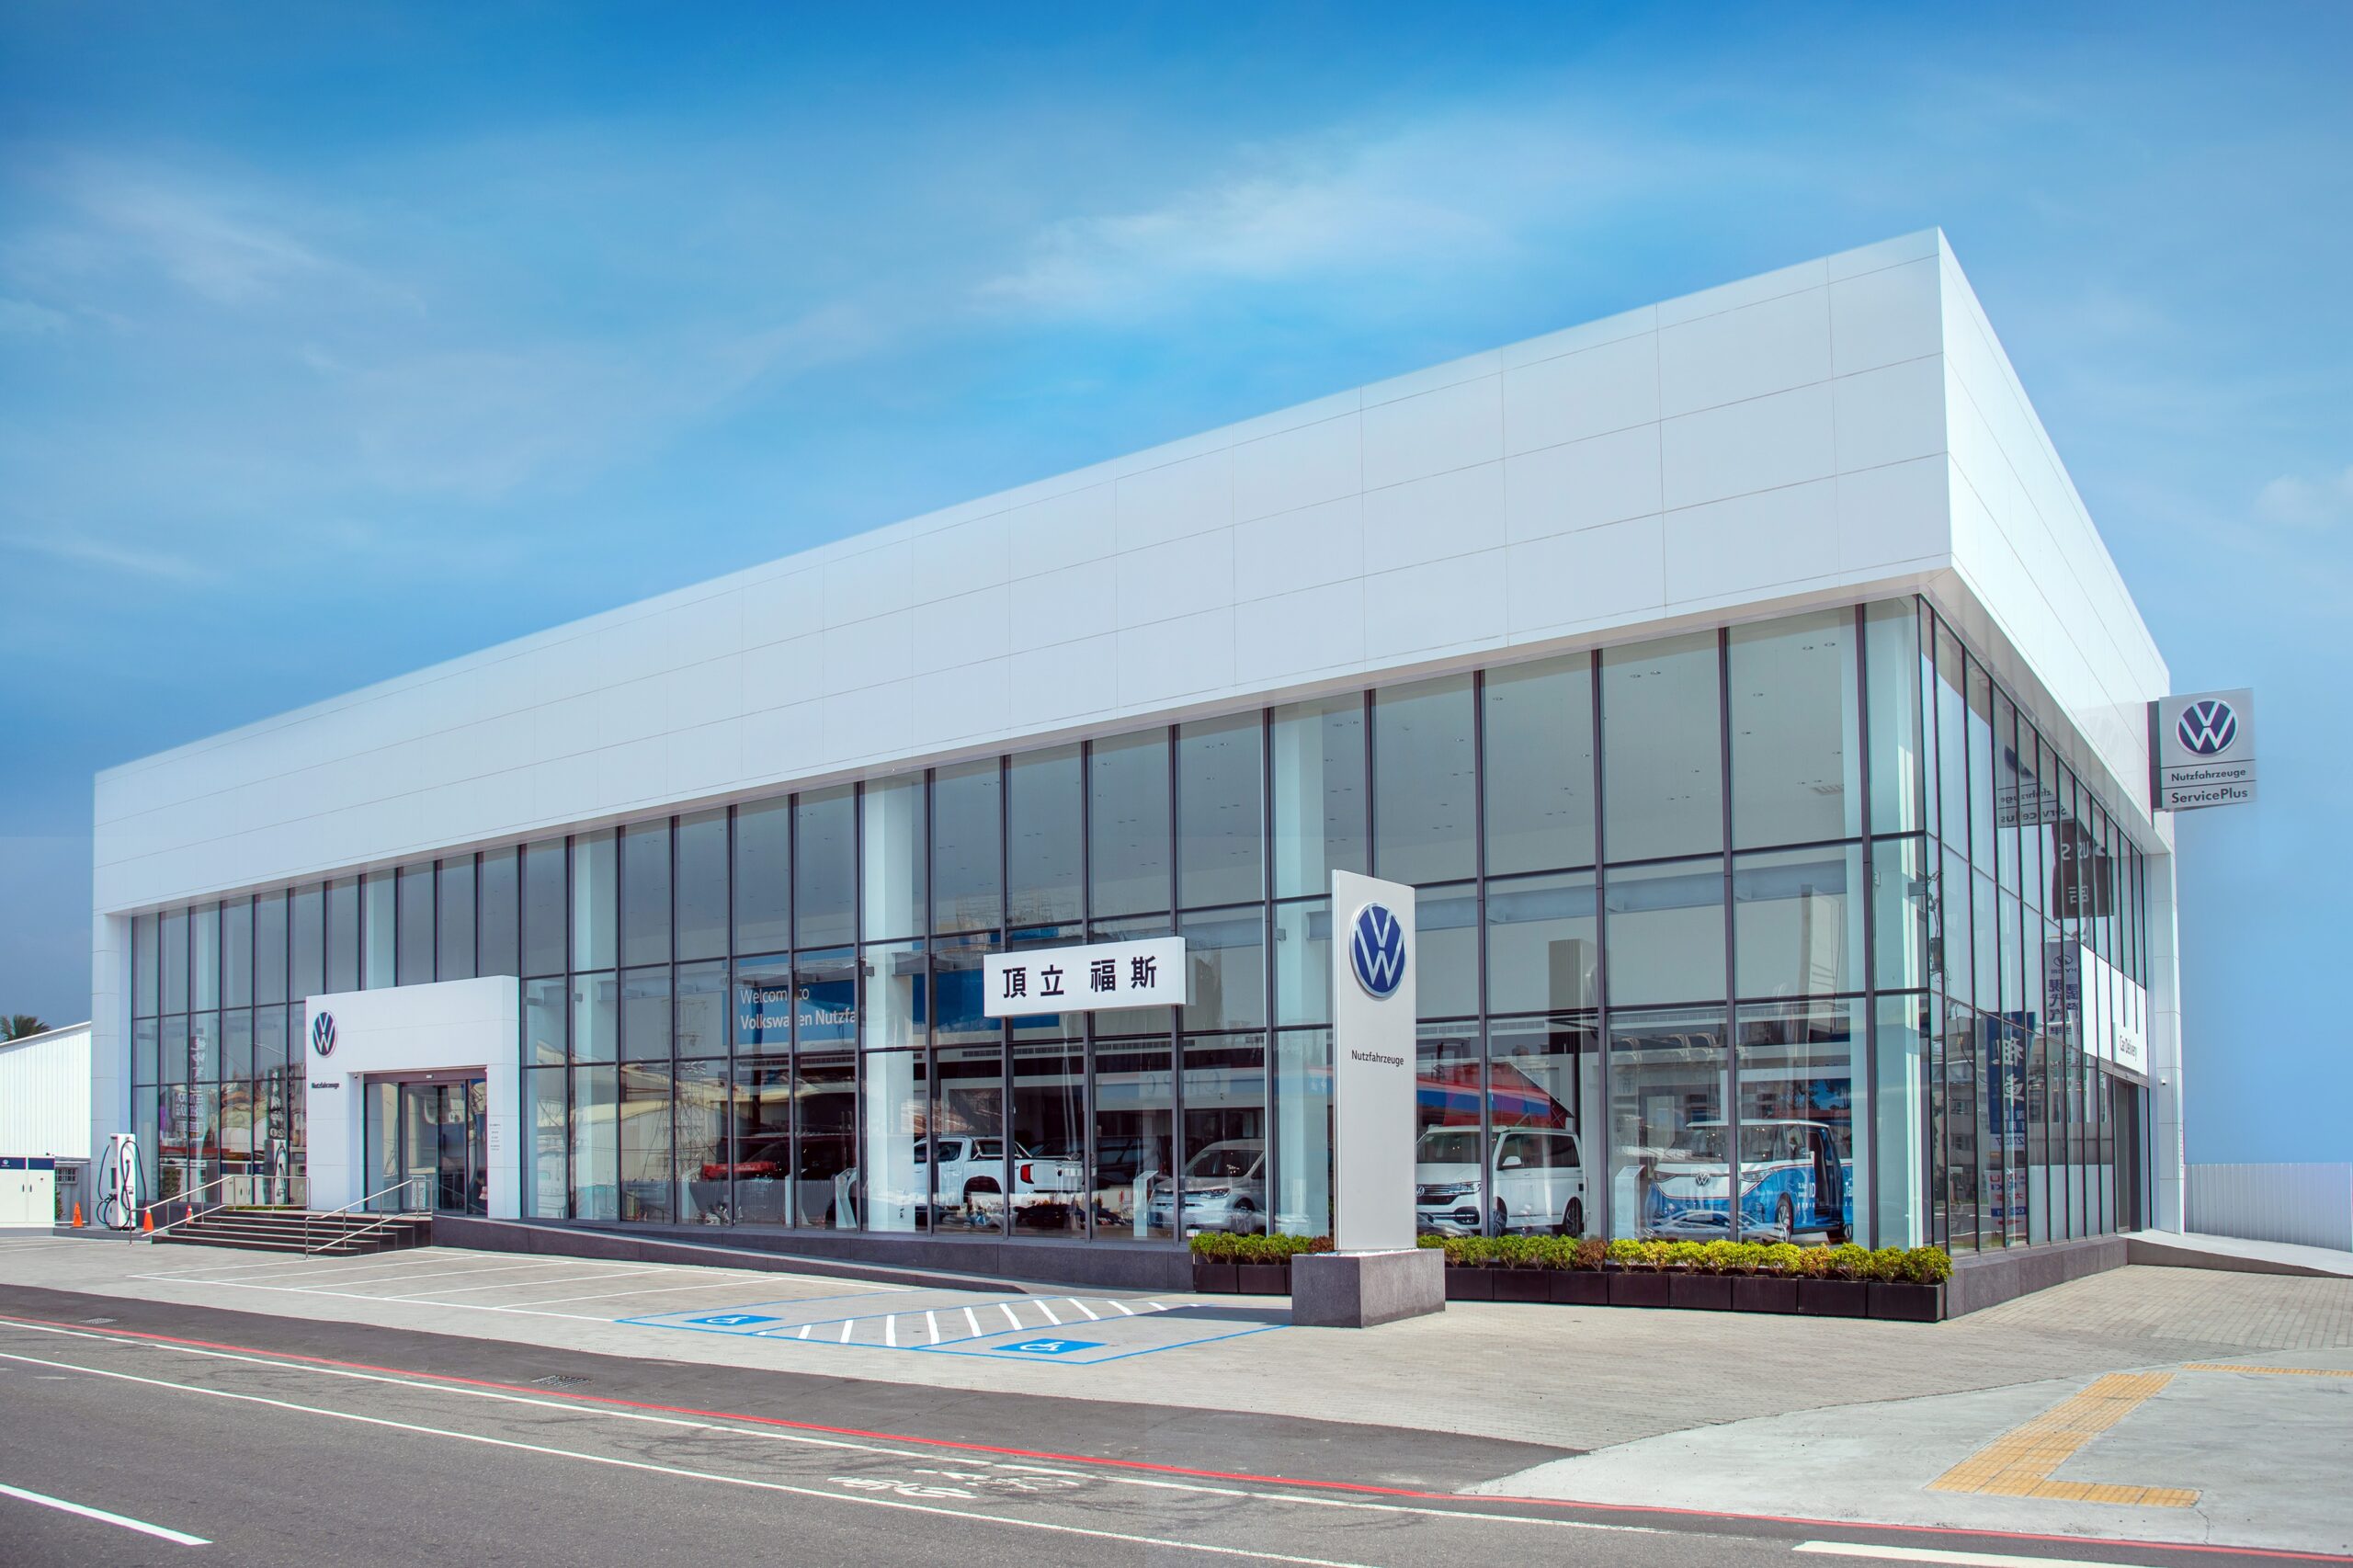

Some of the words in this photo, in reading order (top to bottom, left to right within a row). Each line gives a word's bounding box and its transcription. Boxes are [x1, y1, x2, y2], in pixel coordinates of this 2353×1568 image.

[2171, 769, 2246, 782] Nutzfahrzeuge
[2171, 787, 2248, 803] ServicePlus
[740, 988, 788, 1005] Welcom
[740, 1013, 813, 1030] Volkswaen
[1351, 1049, 1404, 1068] Nutzfahrzeuge
